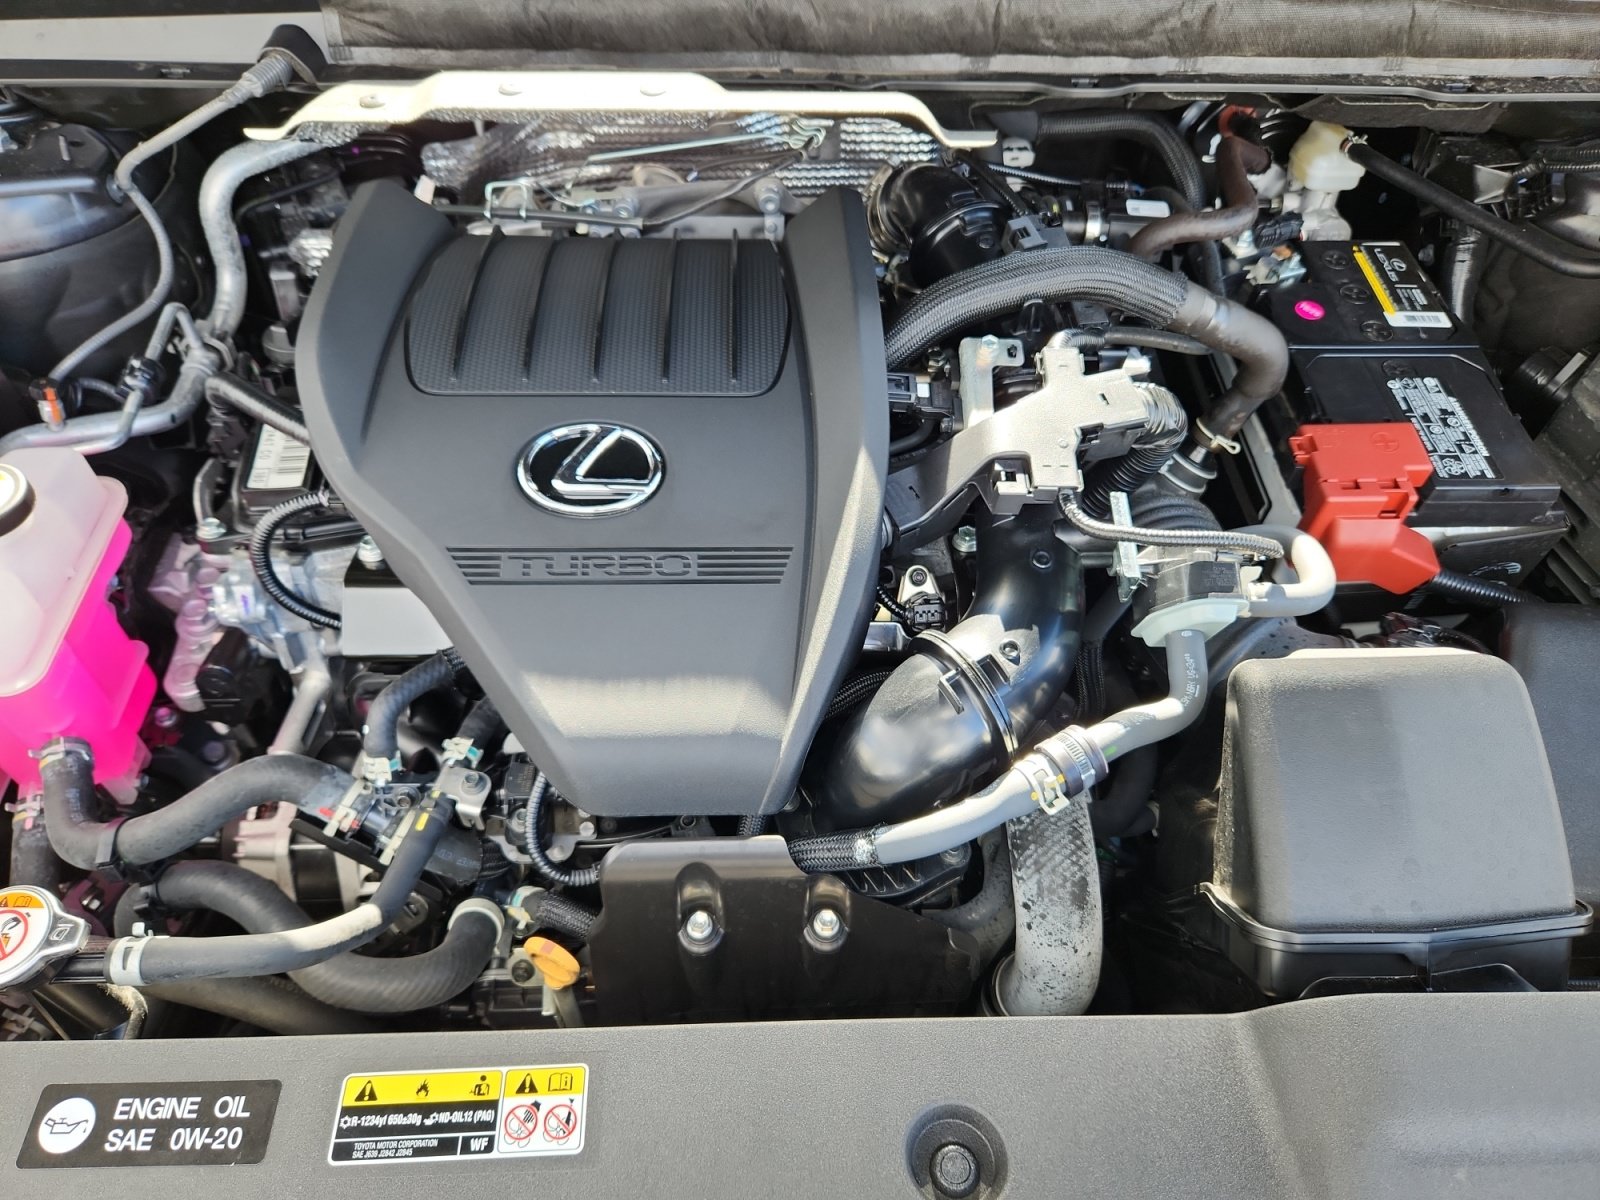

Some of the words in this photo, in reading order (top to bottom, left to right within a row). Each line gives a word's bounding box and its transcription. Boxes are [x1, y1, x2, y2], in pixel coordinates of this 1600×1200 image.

[1374, 248, 1399, 282] LEXUS
[508, 554, 692, 576] TURBO
[113, 1097, 202, 1121] ENGINE
[213, 1095, 250, 1119] OIL
[473, 1110, 495, 1123] (PAG)
[104, 1128, 156, 1152] SAE
[169, 1127, 243, 1150] 0W-20
[354, 1140, 376, 1150] TOYOTA
[376, 1140, 397, 1149] MOTOR
[397, 1138, 439, 1149] CORPORATION
[469, 1137, 489, 1151] WF
[352, 1150, 364, 1159] SAE
